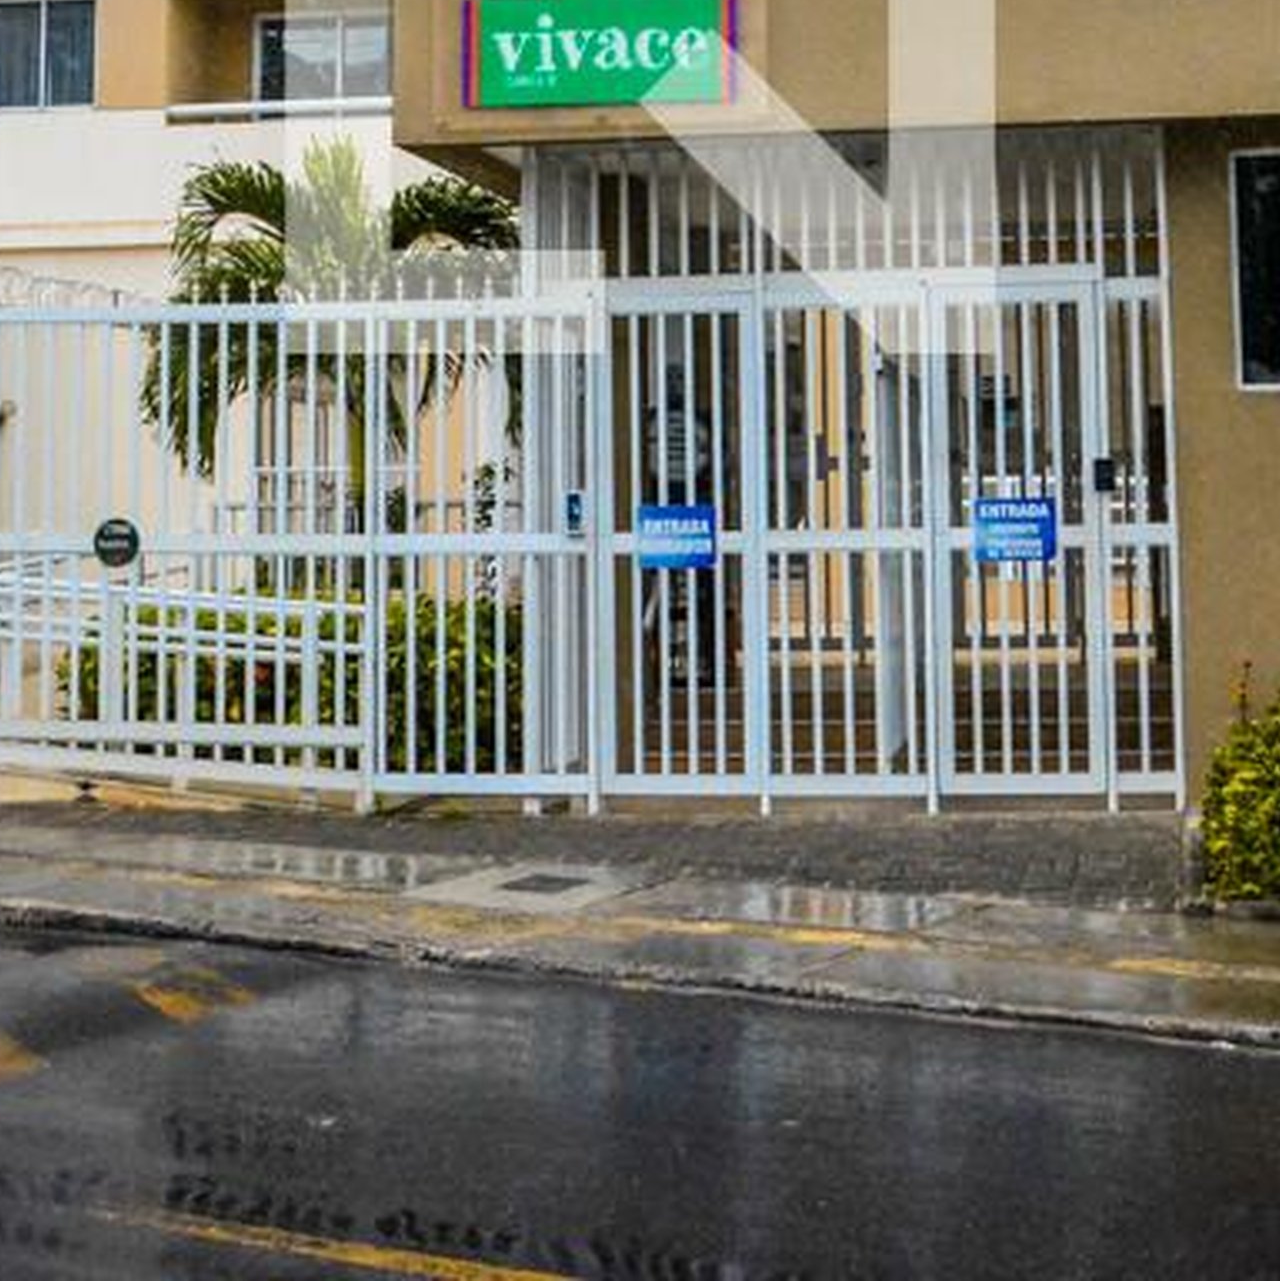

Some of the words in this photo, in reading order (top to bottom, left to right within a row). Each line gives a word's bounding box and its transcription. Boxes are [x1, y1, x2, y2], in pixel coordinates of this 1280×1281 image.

[492, 13, 709, 73] vivace
[979, 502, 1050, 519] ENTRADA
[643, 518, 710, 535] ENTRADA
